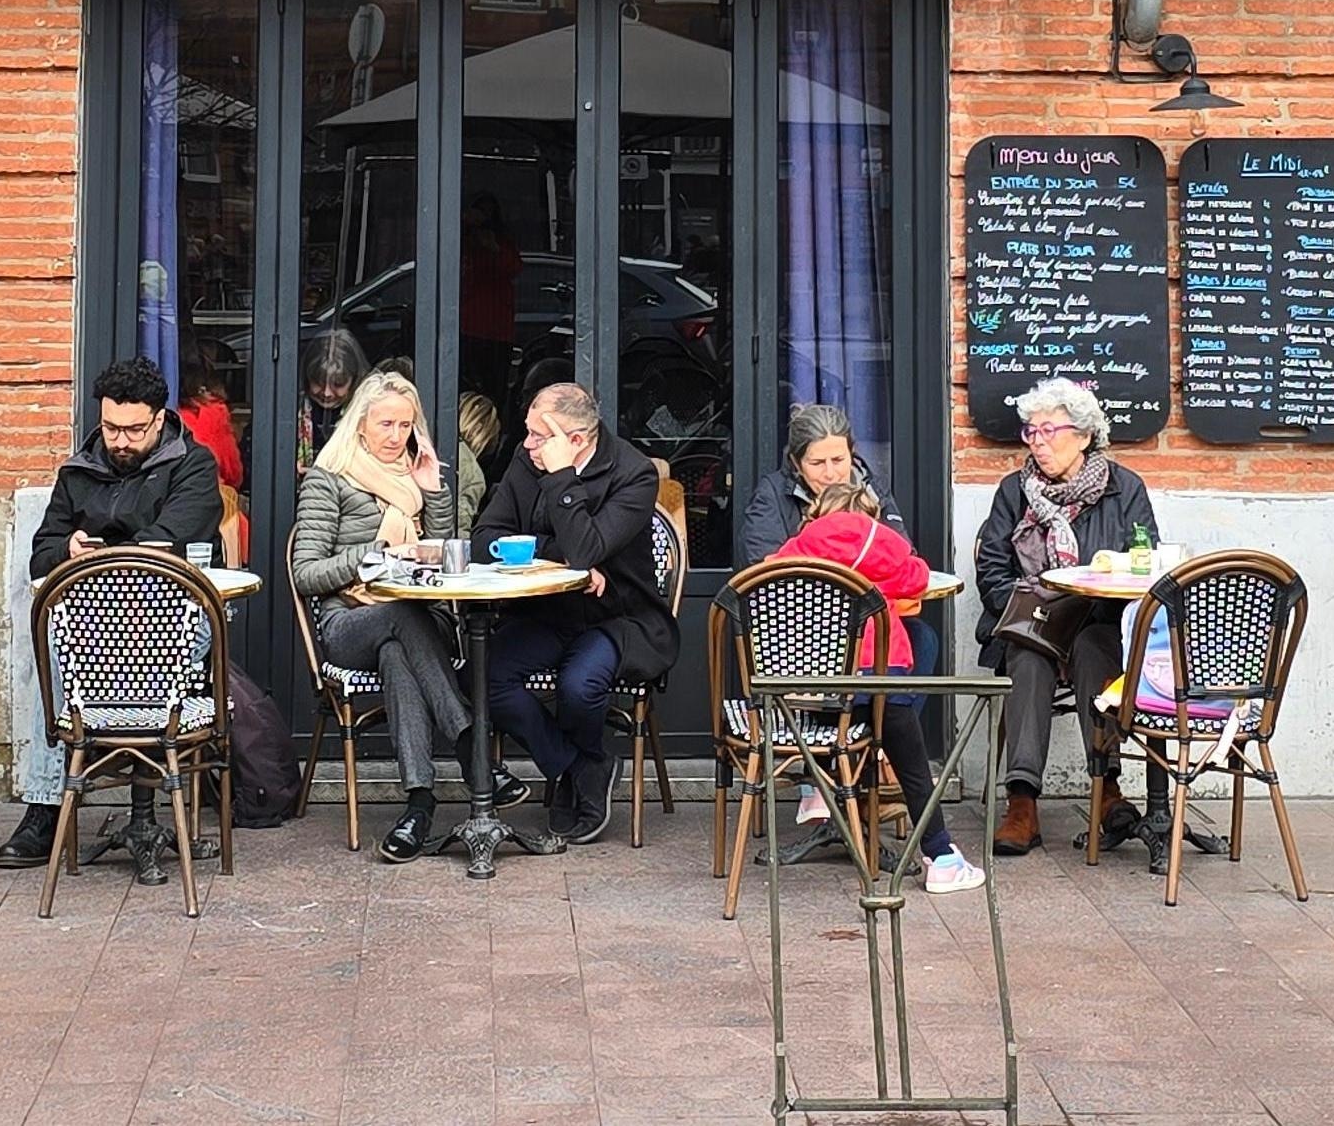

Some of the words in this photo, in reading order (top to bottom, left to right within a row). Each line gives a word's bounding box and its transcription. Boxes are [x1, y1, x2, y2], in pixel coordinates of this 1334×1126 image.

[1054, 148, 1077, 164] du
[991, 175, 1041, 189] ENTRÉE
[1046, 177, 1061, 189] DU
[1065, 177, 1098, 190] JOUR
[1046, 244, 1061, 256] DU
[1064, 244, 1095, 257] JOUR
[970, 344, 1018, 356] DESSERT
[1024, 344, 1040, 356] DU
[1043, 344, 1075, 356] JOUR
